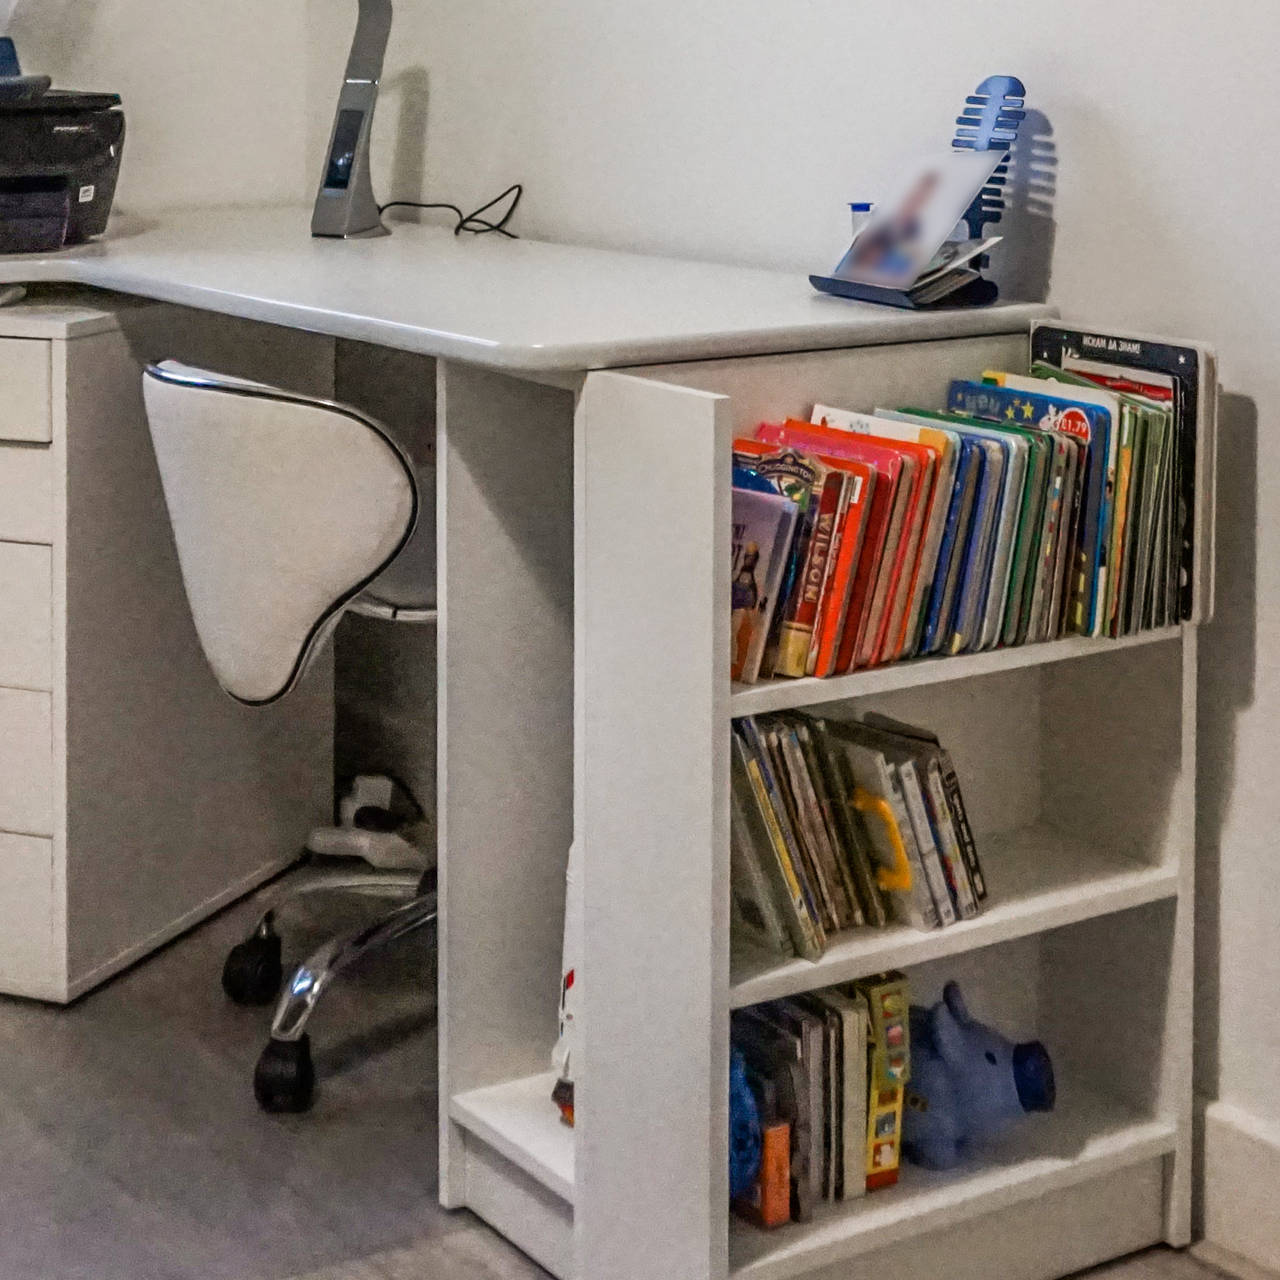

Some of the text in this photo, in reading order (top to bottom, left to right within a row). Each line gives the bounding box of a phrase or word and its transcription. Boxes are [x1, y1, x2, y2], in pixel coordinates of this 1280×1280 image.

[1108, 338, 1117, 351] ДА
[1061, 418, 1087, 433] £1.79
[804, 513, 834, 603] WILSON
